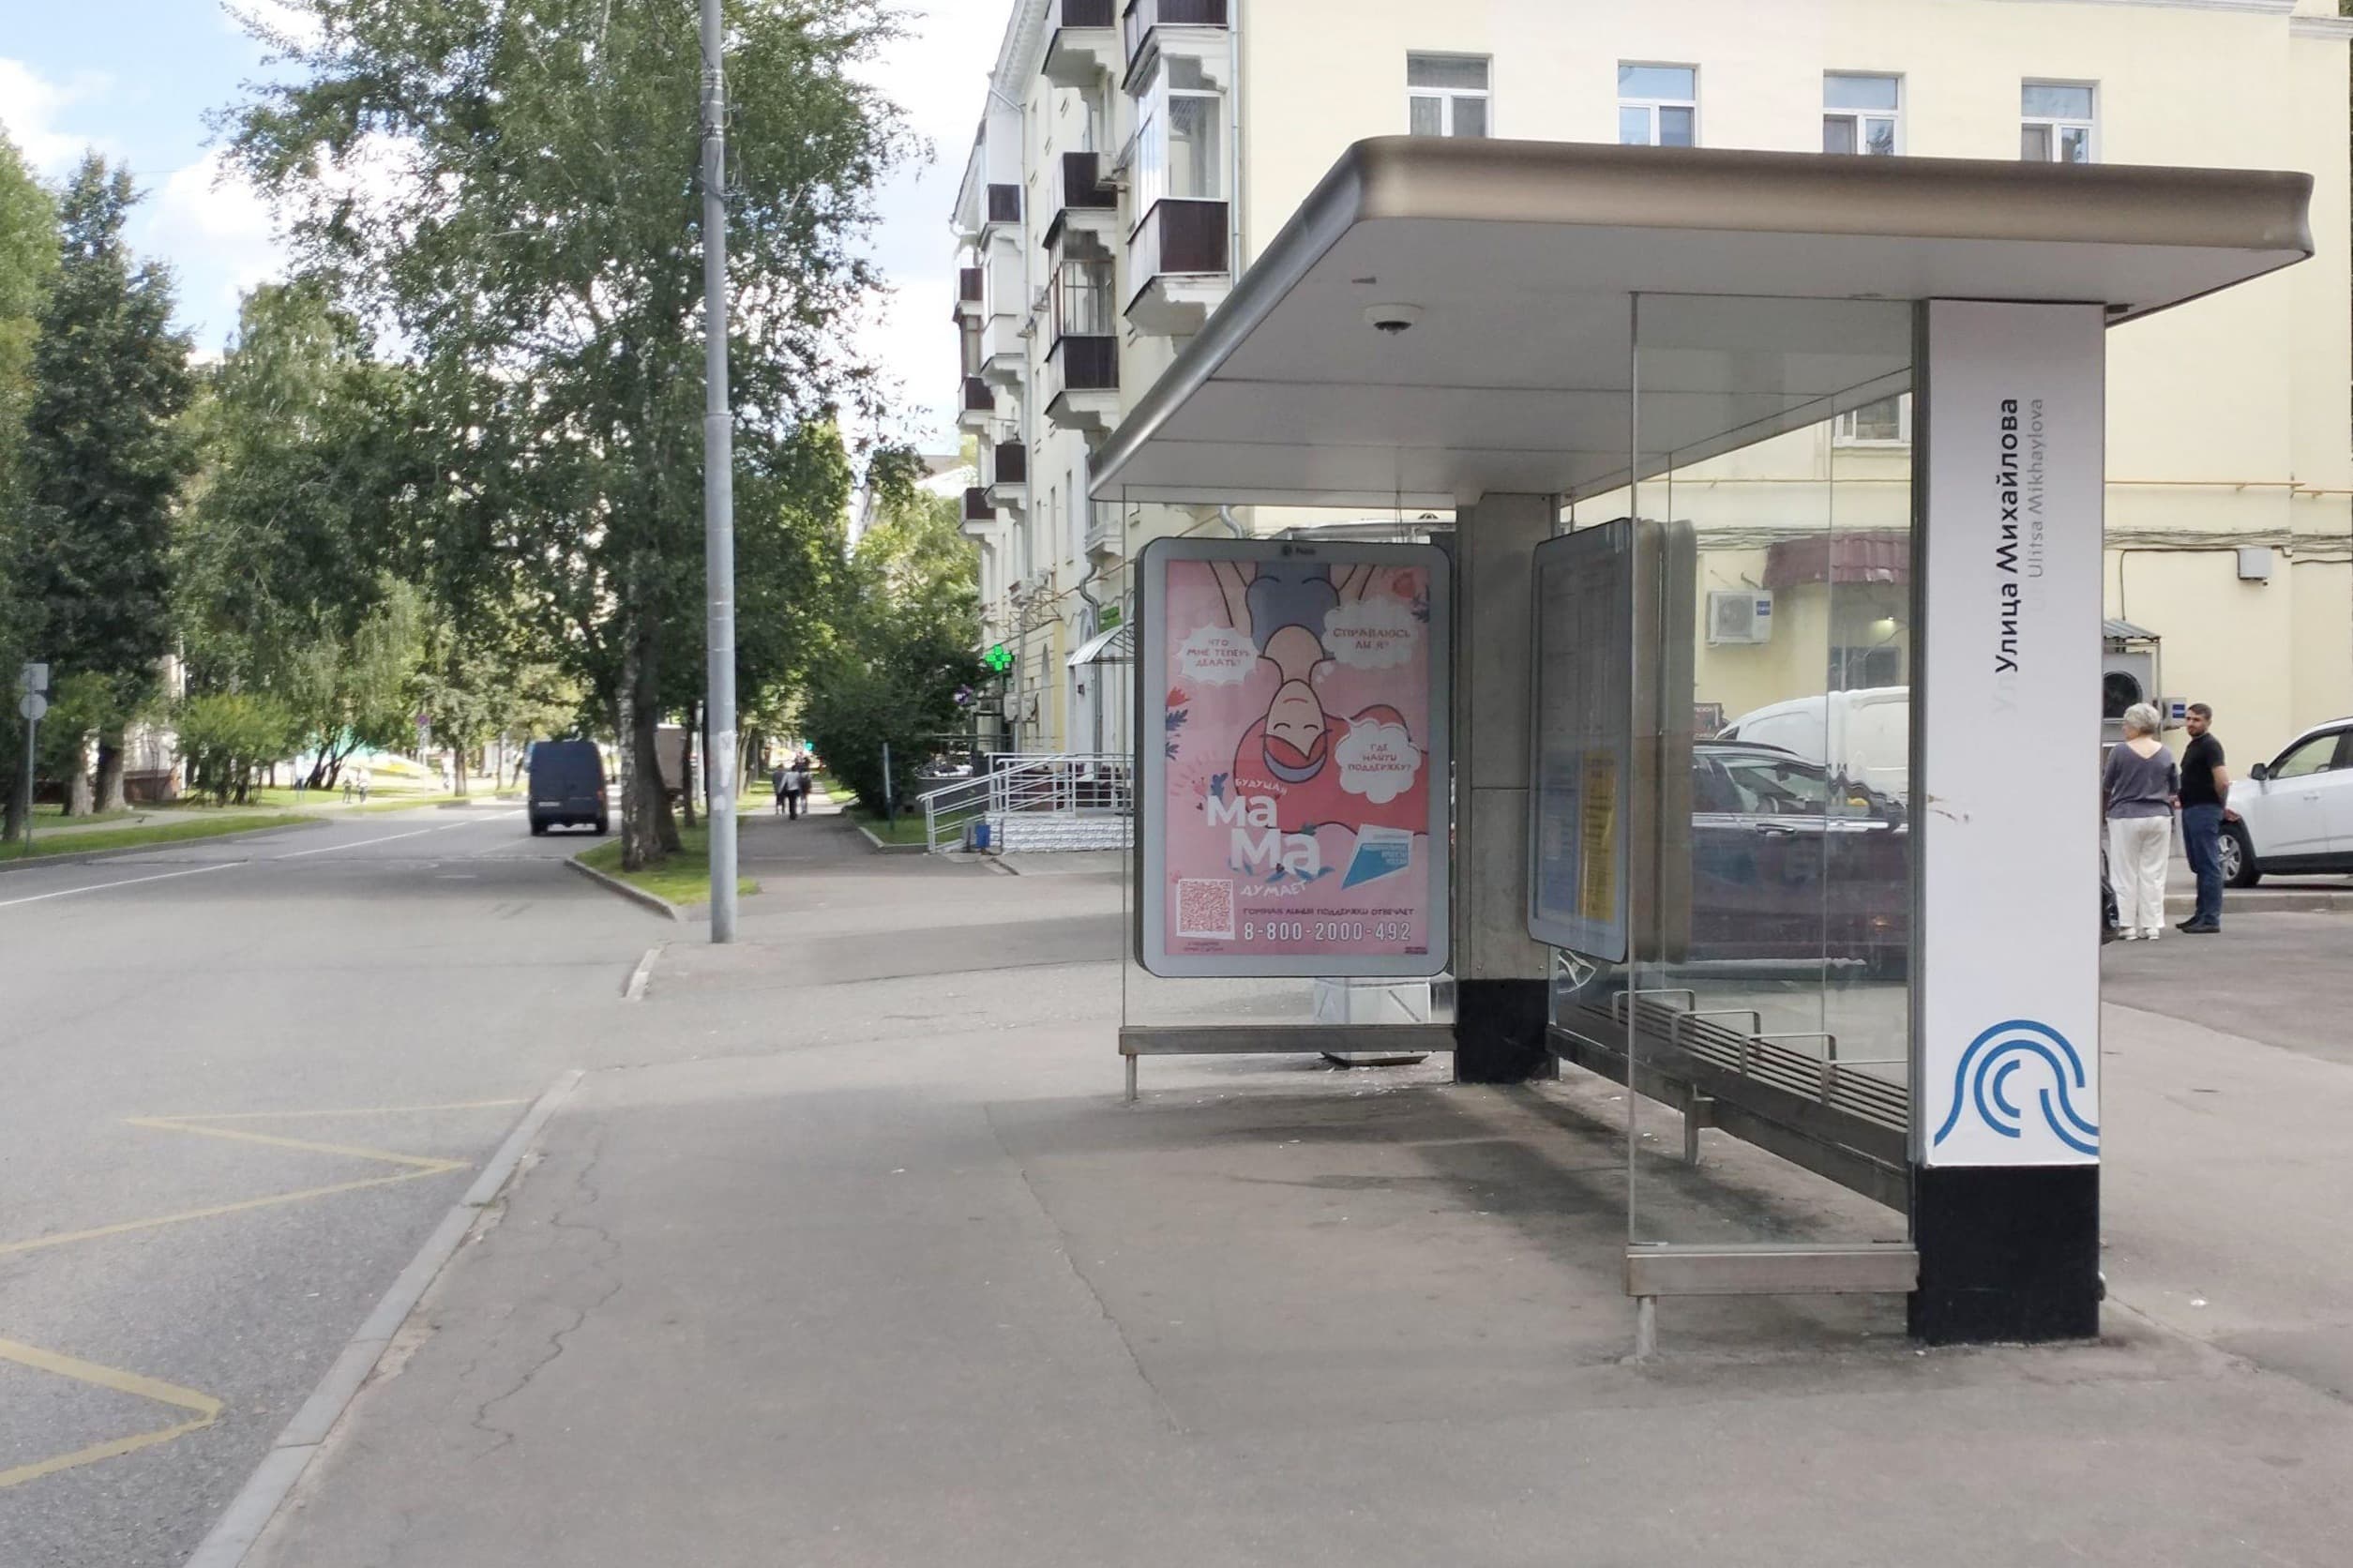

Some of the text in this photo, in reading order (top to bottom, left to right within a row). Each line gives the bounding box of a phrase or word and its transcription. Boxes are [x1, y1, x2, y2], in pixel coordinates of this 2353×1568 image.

[1996, 399, 2018, 574] Михайлова
[2027, 399, 2045, 514] Mikhaylova
[2028, 520, 2044, 578] Ulitsa
[1995, 582, 2022, 673] Улица
[1241, 879, 1306, 897] ДУМАЕТ
[1244, 922, 1410, 941] 8-800-2000-492
